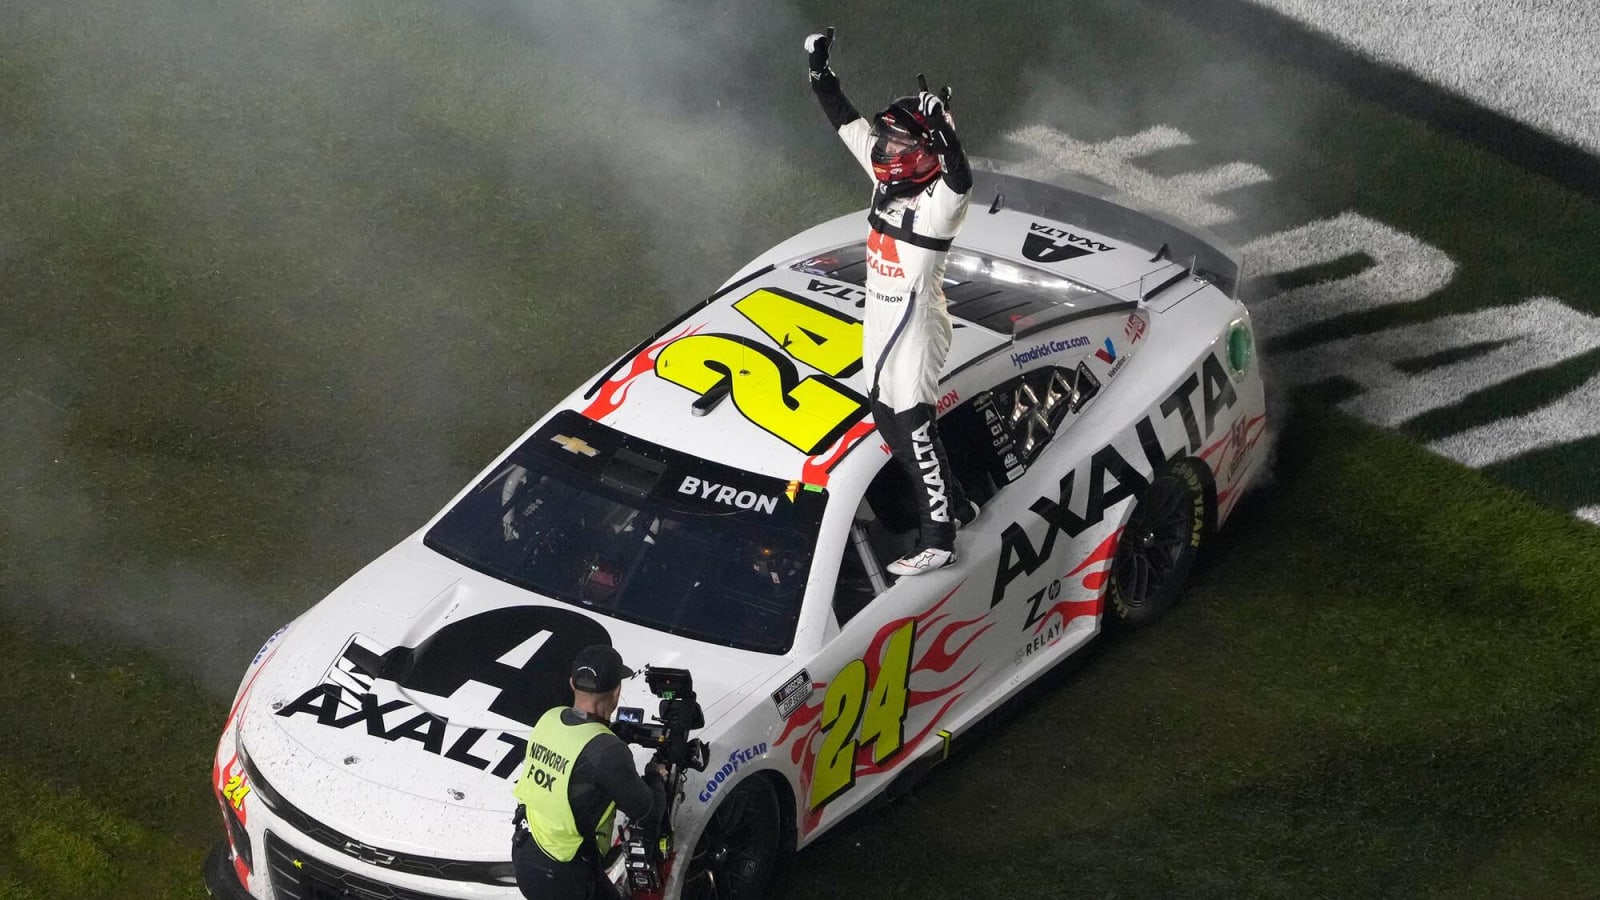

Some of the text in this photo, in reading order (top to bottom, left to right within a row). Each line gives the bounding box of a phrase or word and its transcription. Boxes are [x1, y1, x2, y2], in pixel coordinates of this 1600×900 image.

[1030, 222, 1117, 251] AXALTA
[867, 255, 905, 278] XALTA
[877, 292, 903, 303] BYRON
[654, 286, 867, 456] 24
[937, 389, 959, 413] RON
[911, 420, 950, 523] AXALTA
[990, 352, 1237, 609] AXALTA
[677, 475, 778, 514] BYRON
[1026, 621, 1062, 656] RELAY
[274, 682, 529, 784] AXALT
[809, 620, 918, 813] 24
[529, 741, 569, 775] NETWORK
[699, 742, 767, 803] GOODYEAR
[222, 774, 251, 810] 24
[527, 763, 557, 793] FOX
